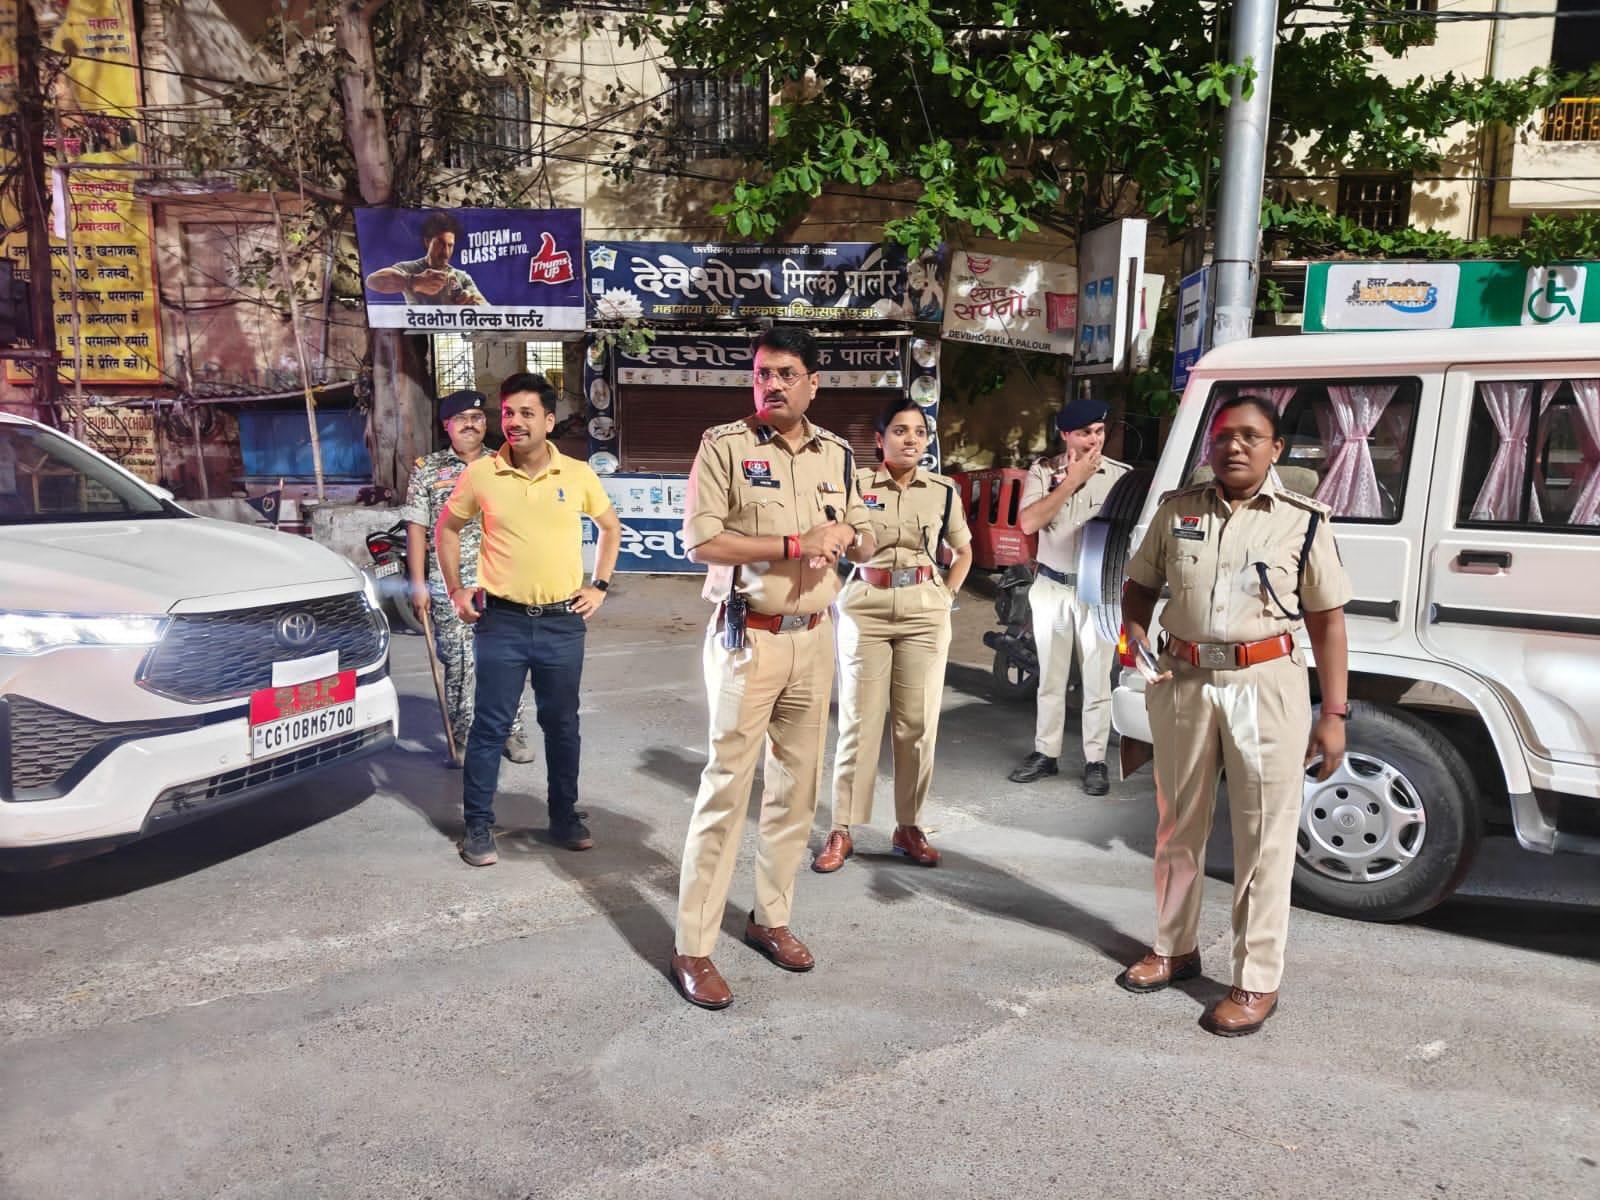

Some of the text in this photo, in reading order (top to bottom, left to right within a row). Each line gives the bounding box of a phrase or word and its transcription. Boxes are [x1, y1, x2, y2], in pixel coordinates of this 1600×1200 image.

[467, 228, 523, 249] TOOFAN KO
[460, 246, 497, 266] GLASS
[498, 246, 509, 257] SE
[532, 257, 570, 275] Thums
[782, 257, 840, 297] मिल्क
[843, 258, 901, 298] पार्लर
[406, 308, 544, 328] देवभोग मिल्क पार्लर
[265, 706, 354, 749] CG10BM6700
